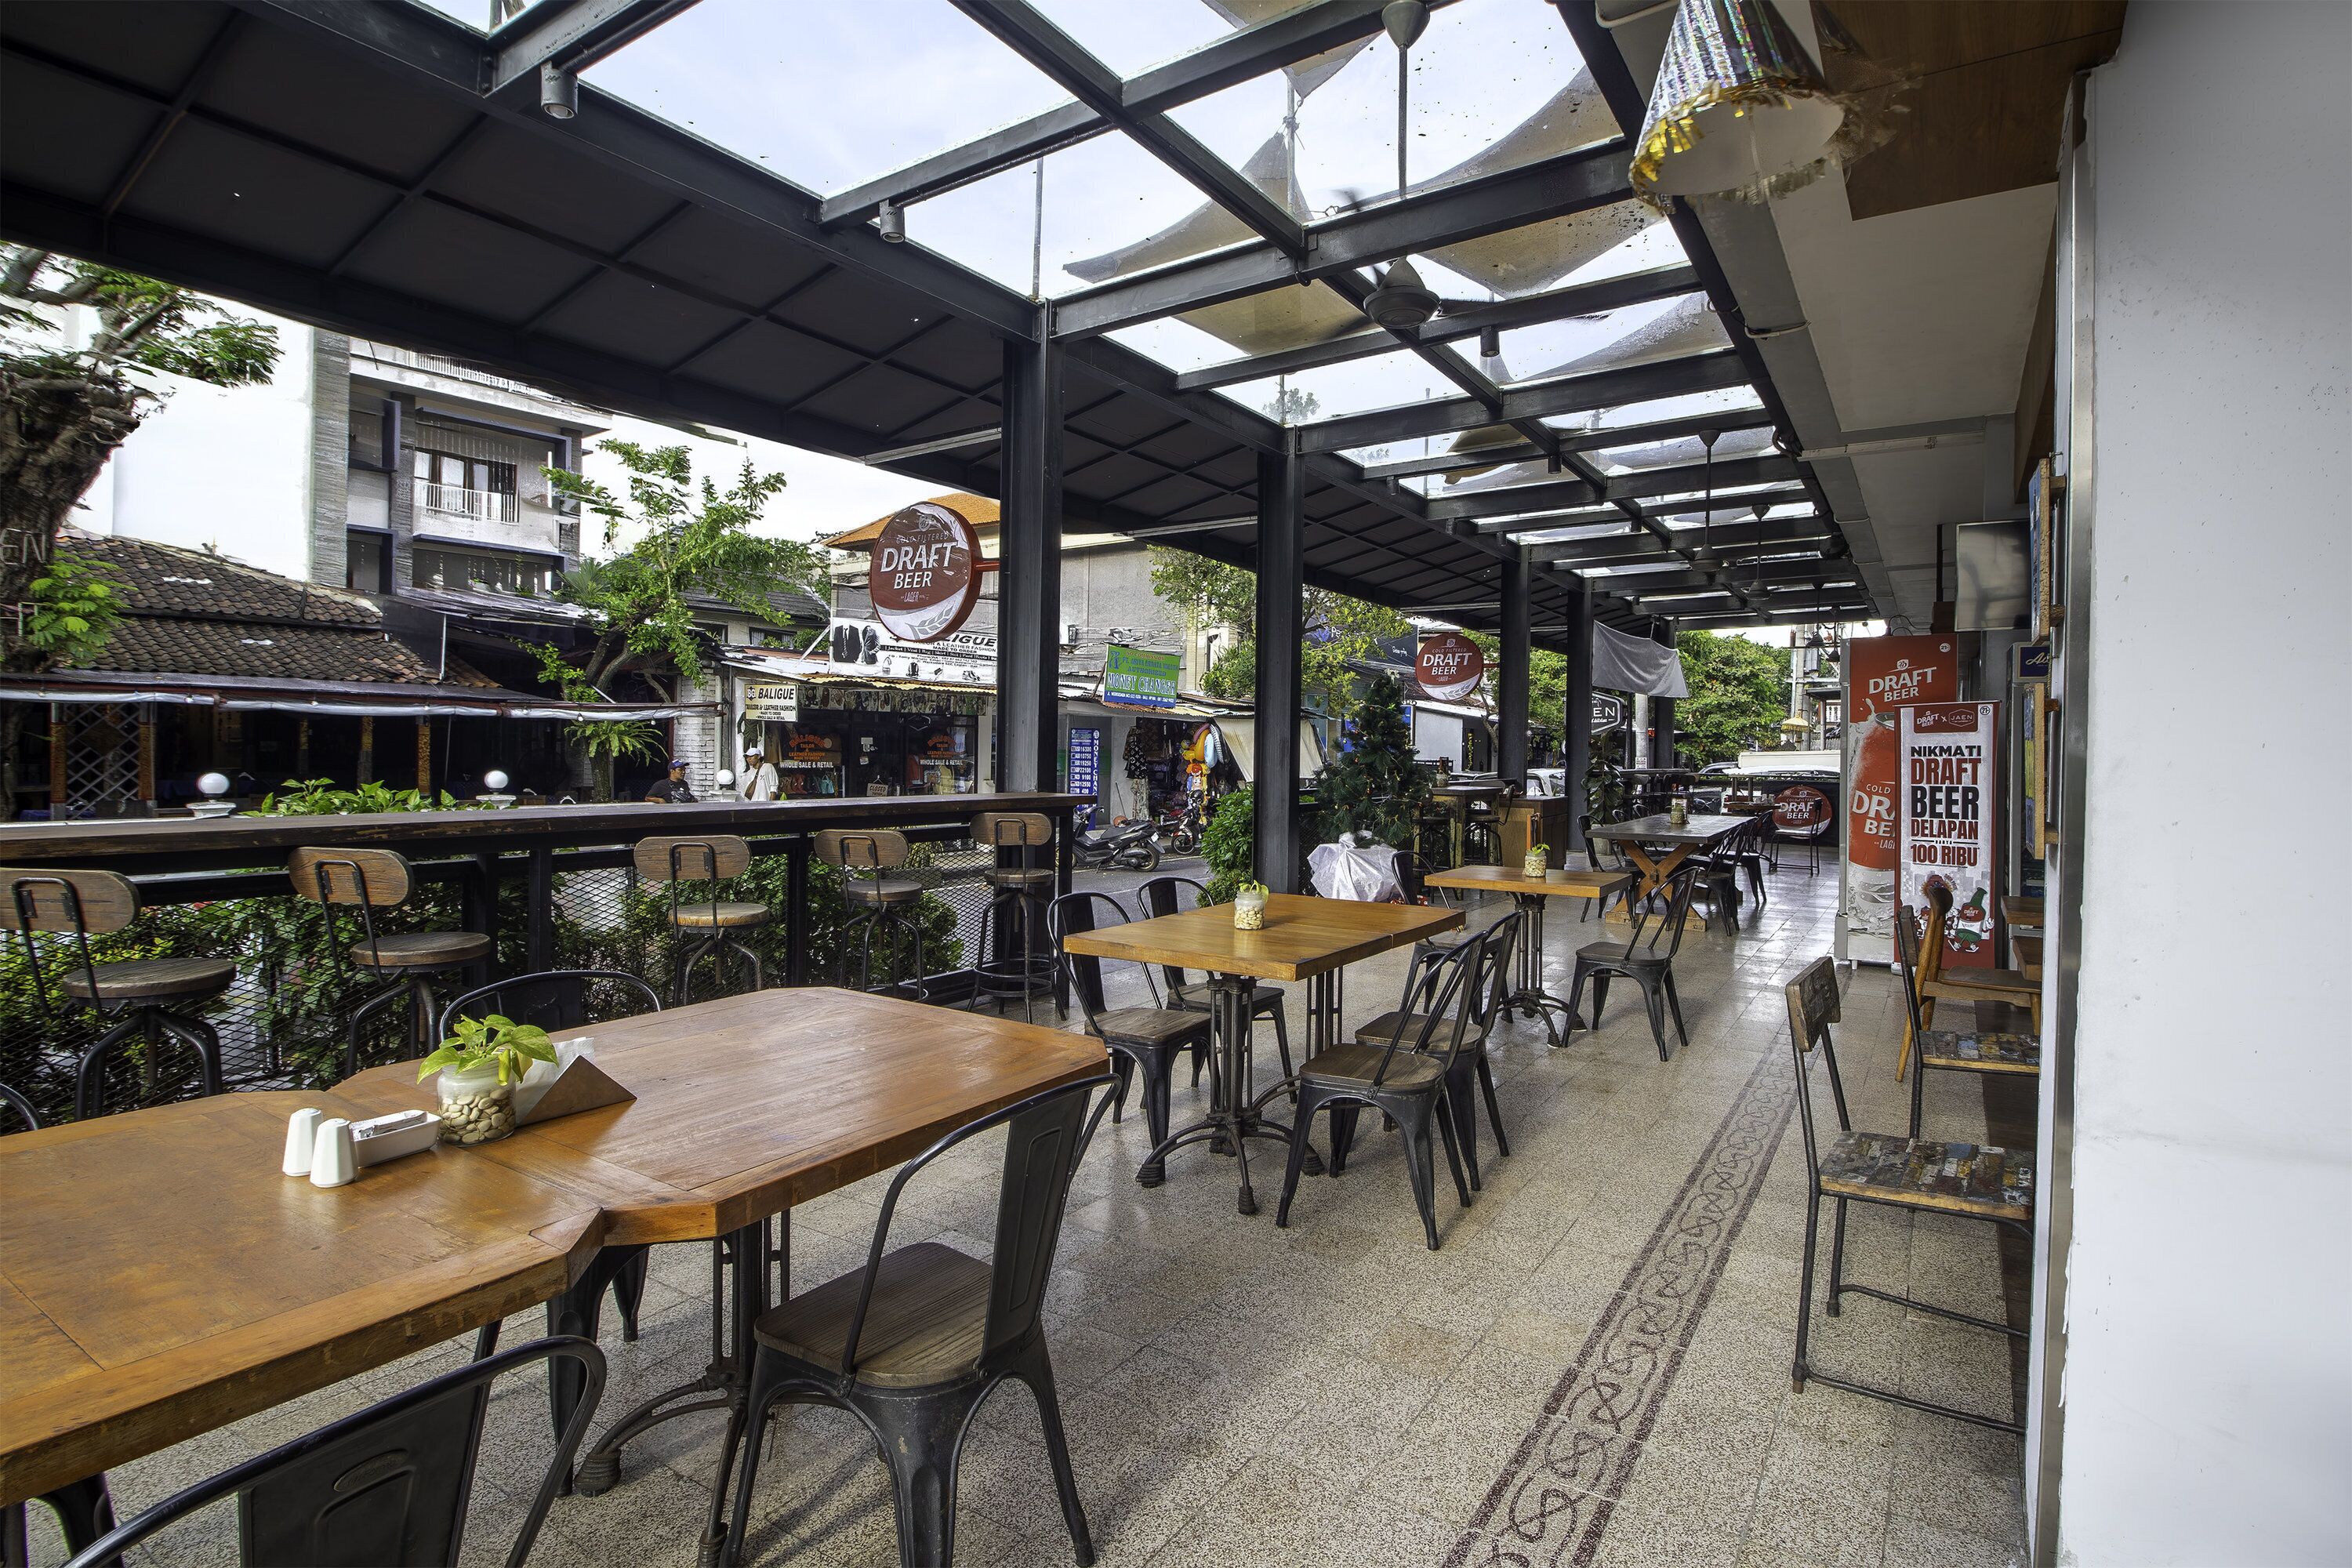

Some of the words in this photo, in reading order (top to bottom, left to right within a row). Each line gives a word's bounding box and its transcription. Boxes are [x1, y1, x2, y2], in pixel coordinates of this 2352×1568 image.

[880, 541, 958, 572] DRAFT
[894, 572, 932, 590] BEER
[1422, 653, 1472, 666] DRAFT
[1432, 666, 1457, 675] BEER
[1107, 672, 1137, 691] MONEY
[1138, 676, 1175, 695] CHANGER
[1869, 666, 1936, 695] DRAFT
[758, 688, 795, 699] BALIGUE
[1884, 687, 1919, 702] BEER
[1593, 706, 1615, 717] EN
[1917, 713, 1940, 724] DRAFT
[1911, 745, 1982, 757] NIKMATI
[1911, 757, 1982, 785] DRAFT
[1866, 784, 1891, 794] COLD
[1778, 802, 1814, 812] DRAF
[1911, 785, 1980, 820] BEER
[1864, 818, 1896, 837] BE
[1911, 818, 1979, 840] DELAPAN
[1879, 839, 1895, 850] LAG
[1911, 844, 1938, 864] 100
